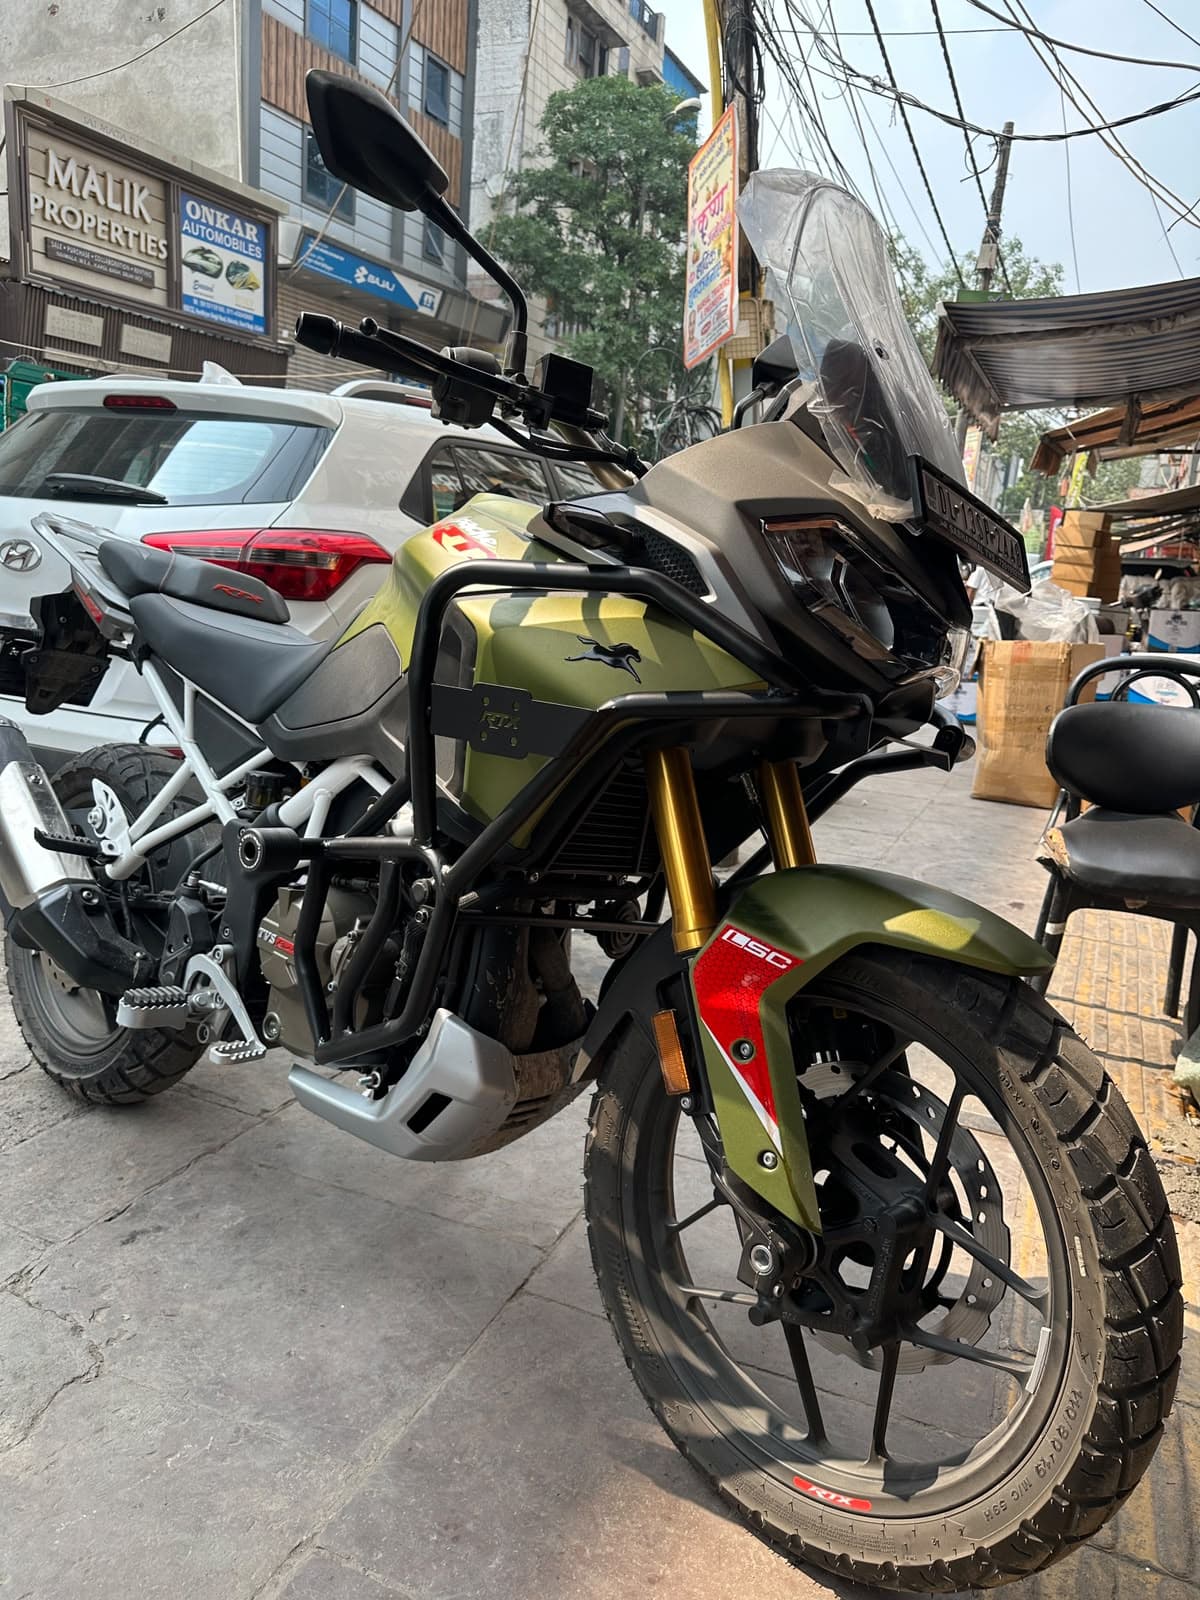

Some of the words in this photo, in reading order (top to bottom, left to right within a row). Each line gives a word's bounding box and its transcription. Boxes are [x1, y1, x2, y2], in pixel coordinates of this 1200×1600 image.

[47, 149, 151, 224] MALIK
[30, 192, 168, 260] PROPERTIES
[186, 200, 259, 243] ONKAR
[50, 240, 62, 250] SALE
[182, 220, 262, 259] AUTOMOBILES
[367, 274, 396, 292] BAJAJ
[212, 583, 265, 604] RTX
[258, 927, 277, 945] TVS
